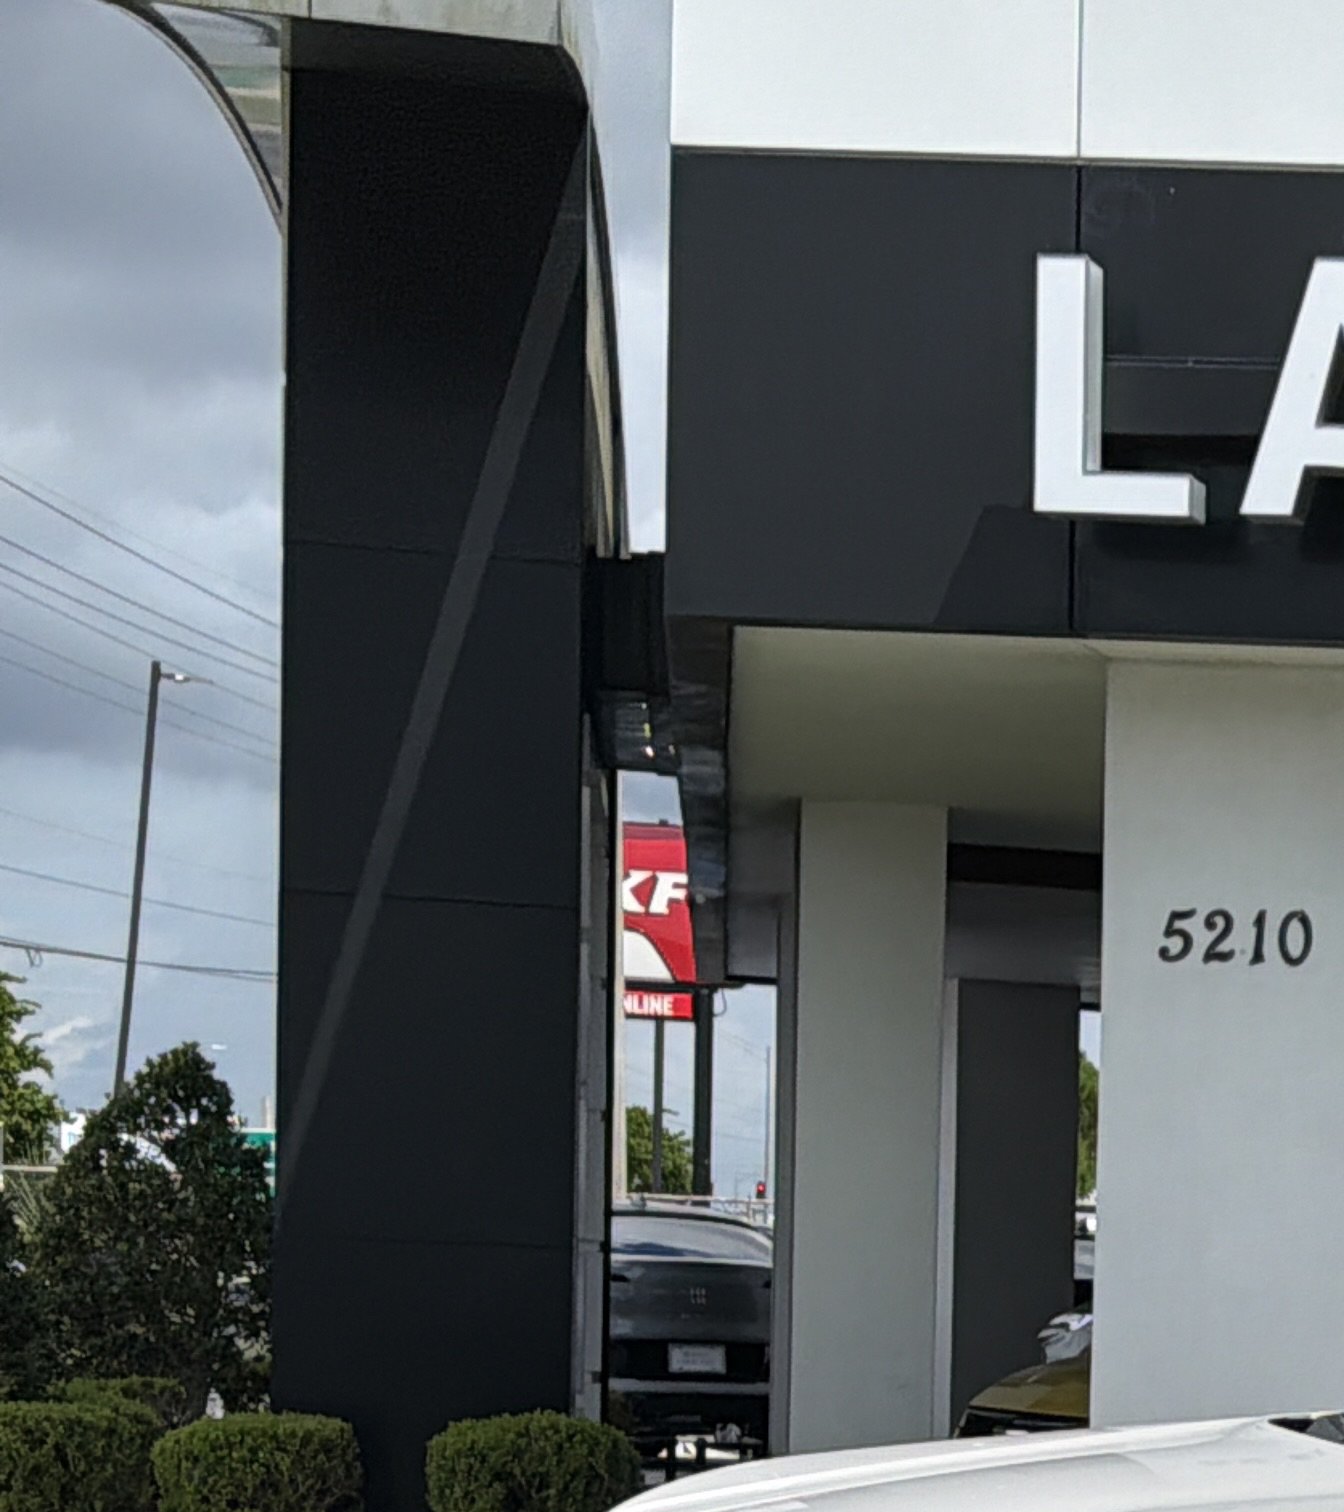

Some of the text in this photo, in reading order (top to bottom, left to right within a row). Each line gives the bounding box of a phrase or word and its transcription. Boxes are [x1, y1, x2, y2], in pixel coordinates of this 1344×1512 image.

[622, 869, 688, 915] KF
[1157, 907, 1314, 967] 5210
[623, 993, 675, 1016] NLINE
